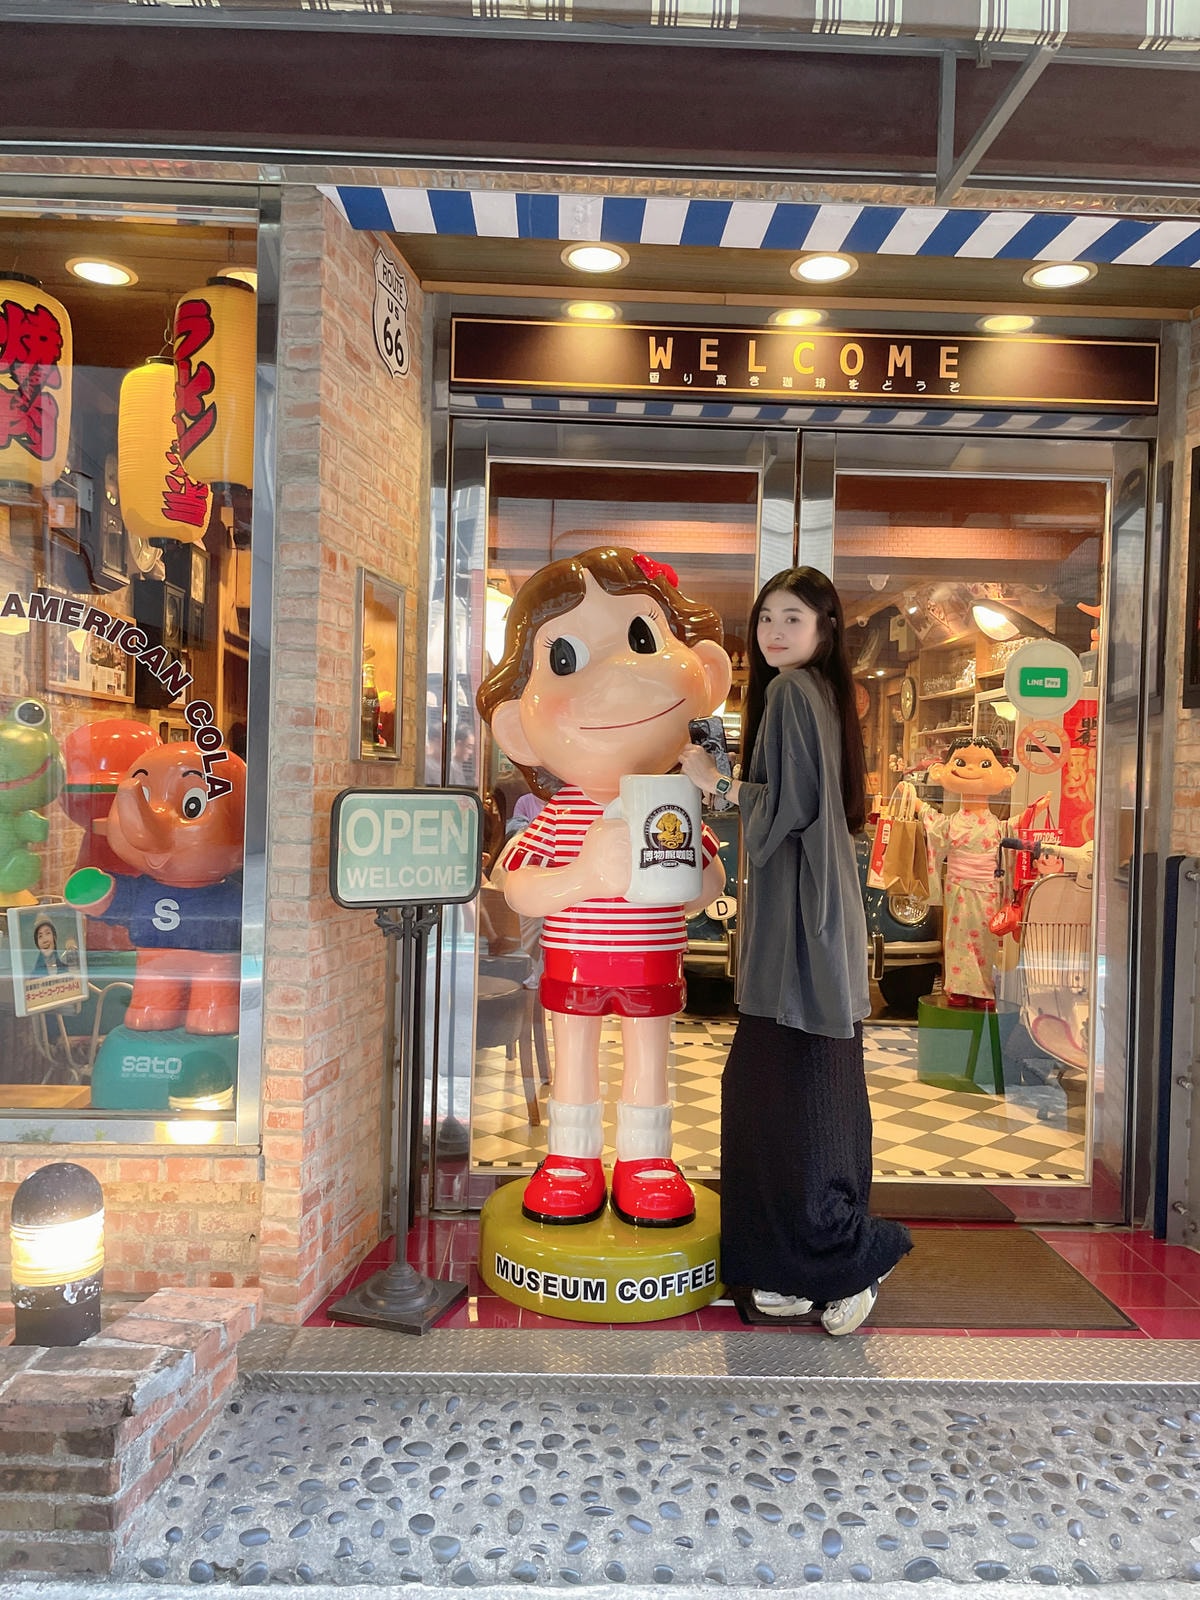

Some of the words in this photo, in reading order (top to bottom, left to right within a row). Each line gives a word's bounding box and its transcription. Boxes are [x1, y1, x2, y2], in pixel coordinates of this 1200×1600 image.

[382, 263, 403, 301] ROUTE
[387, 298, 399, 320] US
[383, 316, 404, 367] 66
[648, 336, 959, 379] WELCOME
[0, 591, 194, 696] AMERICAN
[184, 700, 233, 801] COLA
[345, 808, 469, 857] OPEN
[346, 865, 468, 889] WELCOME
[152, 898, 181, 931] S
[716, 900, 728, 916] D
[121, 1055, 182, 1074] sato
[495, 1252, 606, 1304] MUSEUM
[616, 1259, 717, 1304] COFFEE
